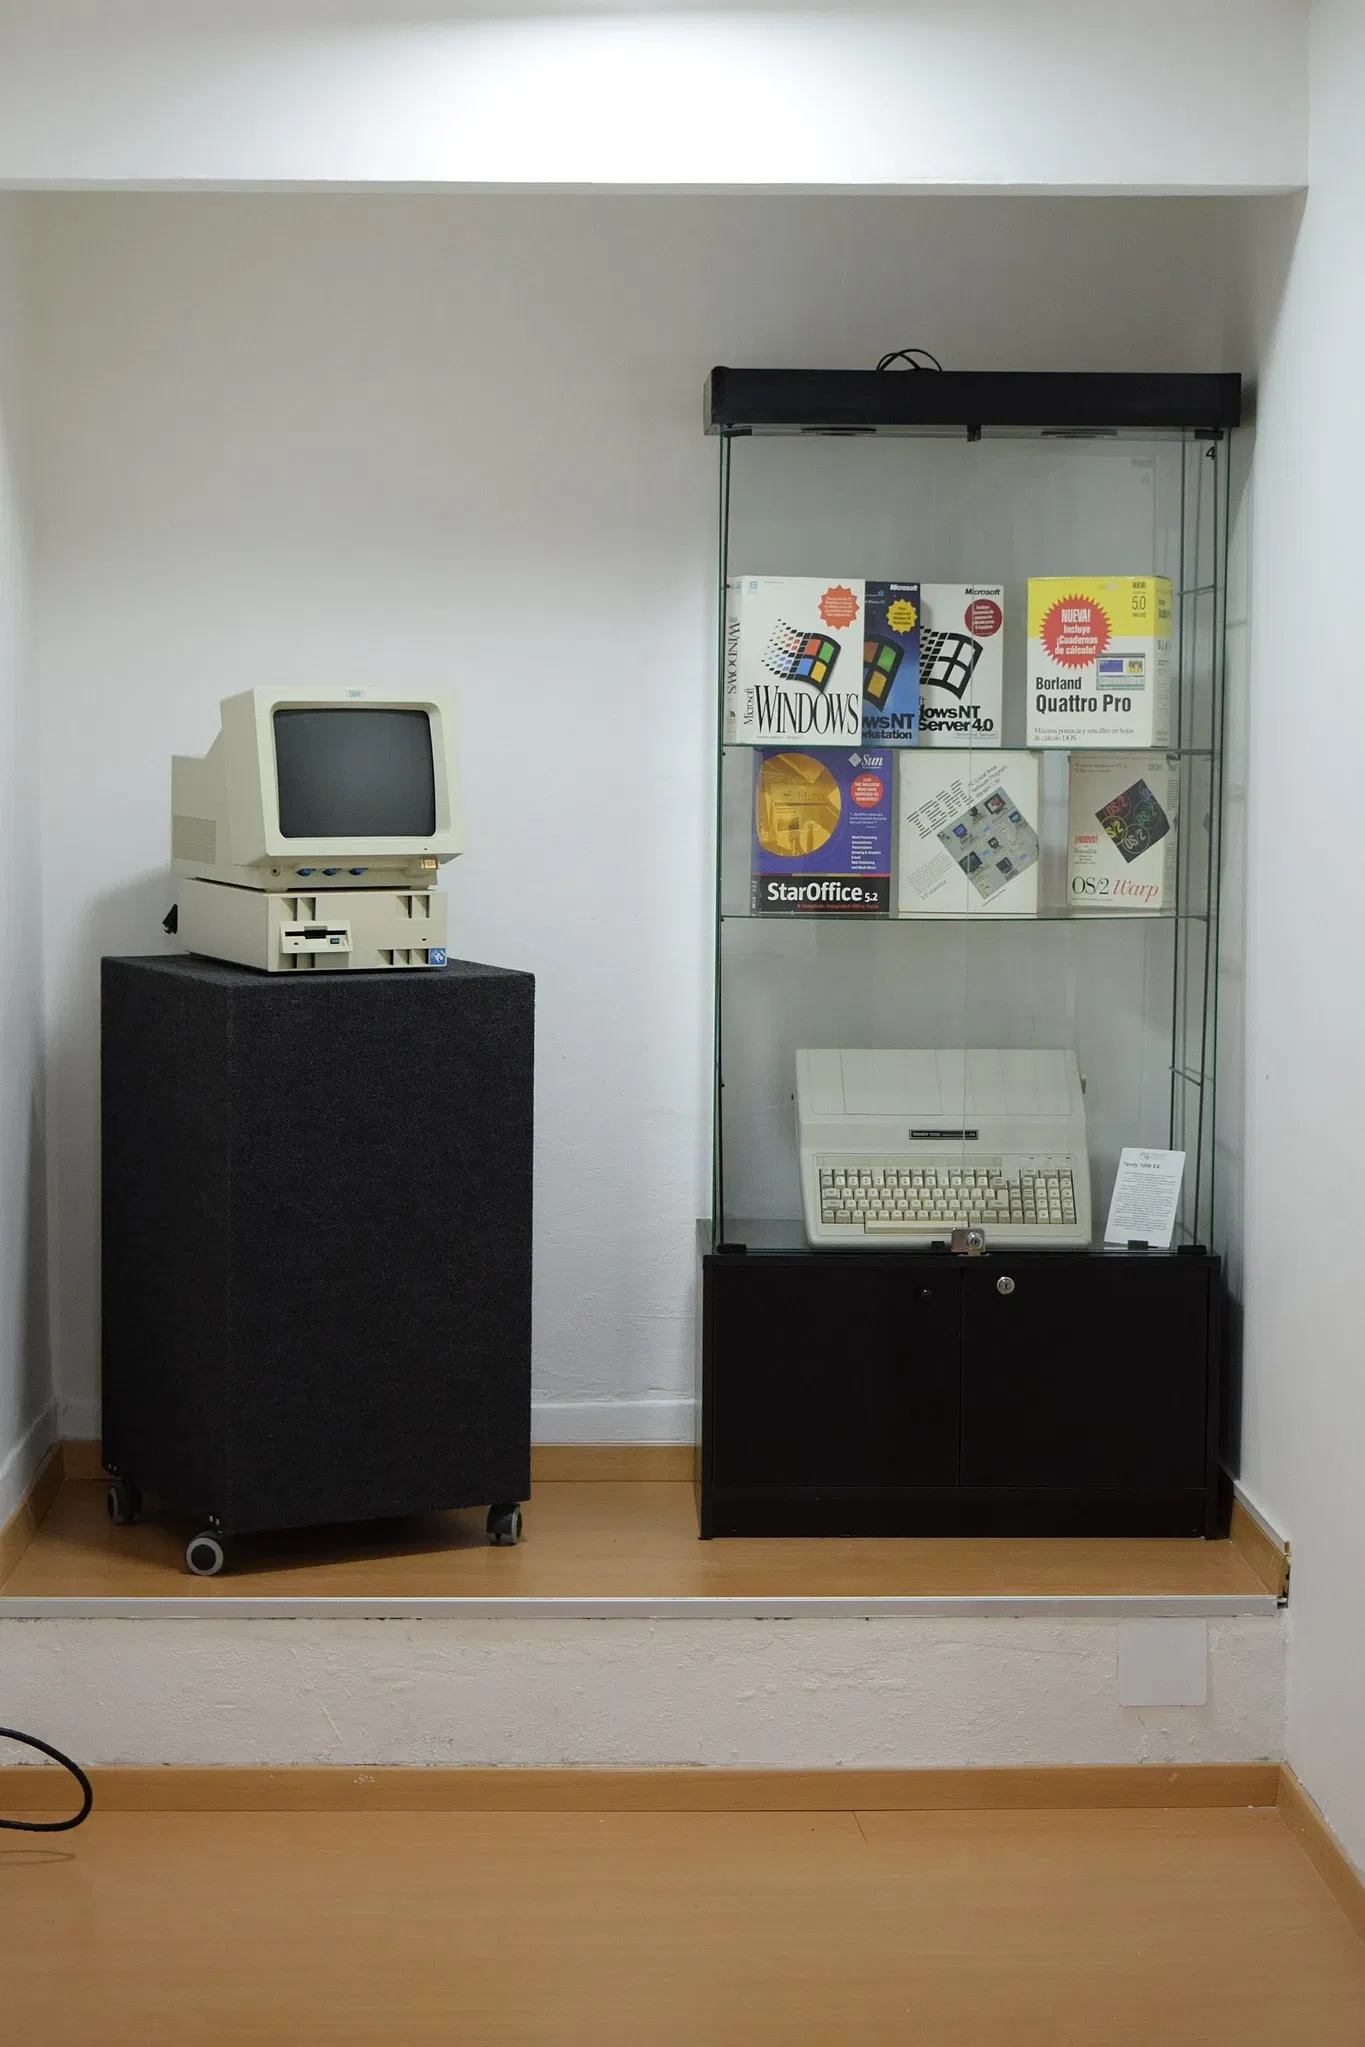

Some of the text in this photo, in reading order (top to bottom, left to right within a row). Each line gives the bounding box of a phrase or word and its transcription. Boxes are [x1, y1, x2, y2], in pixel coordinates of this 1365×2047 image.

[890, 584, 918, 592] Microsoft
[1132, 596, 1146, 610] 5.0
[1062, 609, 1090, 622] NUEVA!
[1064, 625, 1091, 634] Incluye
[1057, 636, 1098, 646] ¡Cuadernos
[1055, 645, 1096, 655] de cálculo!
[727, 622, 740, 695] WINDOWS
[1036, 677, 1082, 690] Borland
[744, 688, 754, 725] Microsoft
[754, 685, 859, 735] WINDOWS
[1036, 694, 1131, 714] Quattro Pro
[972, 719, 993, 731] 4.0
[862, 754, 883, 766] Sun
[906, 779, 974, 840] IBM
[767, 882, 878, 902] StarOffice 5.2
[1072, 876, 1158, 903] OS/2 Warp
